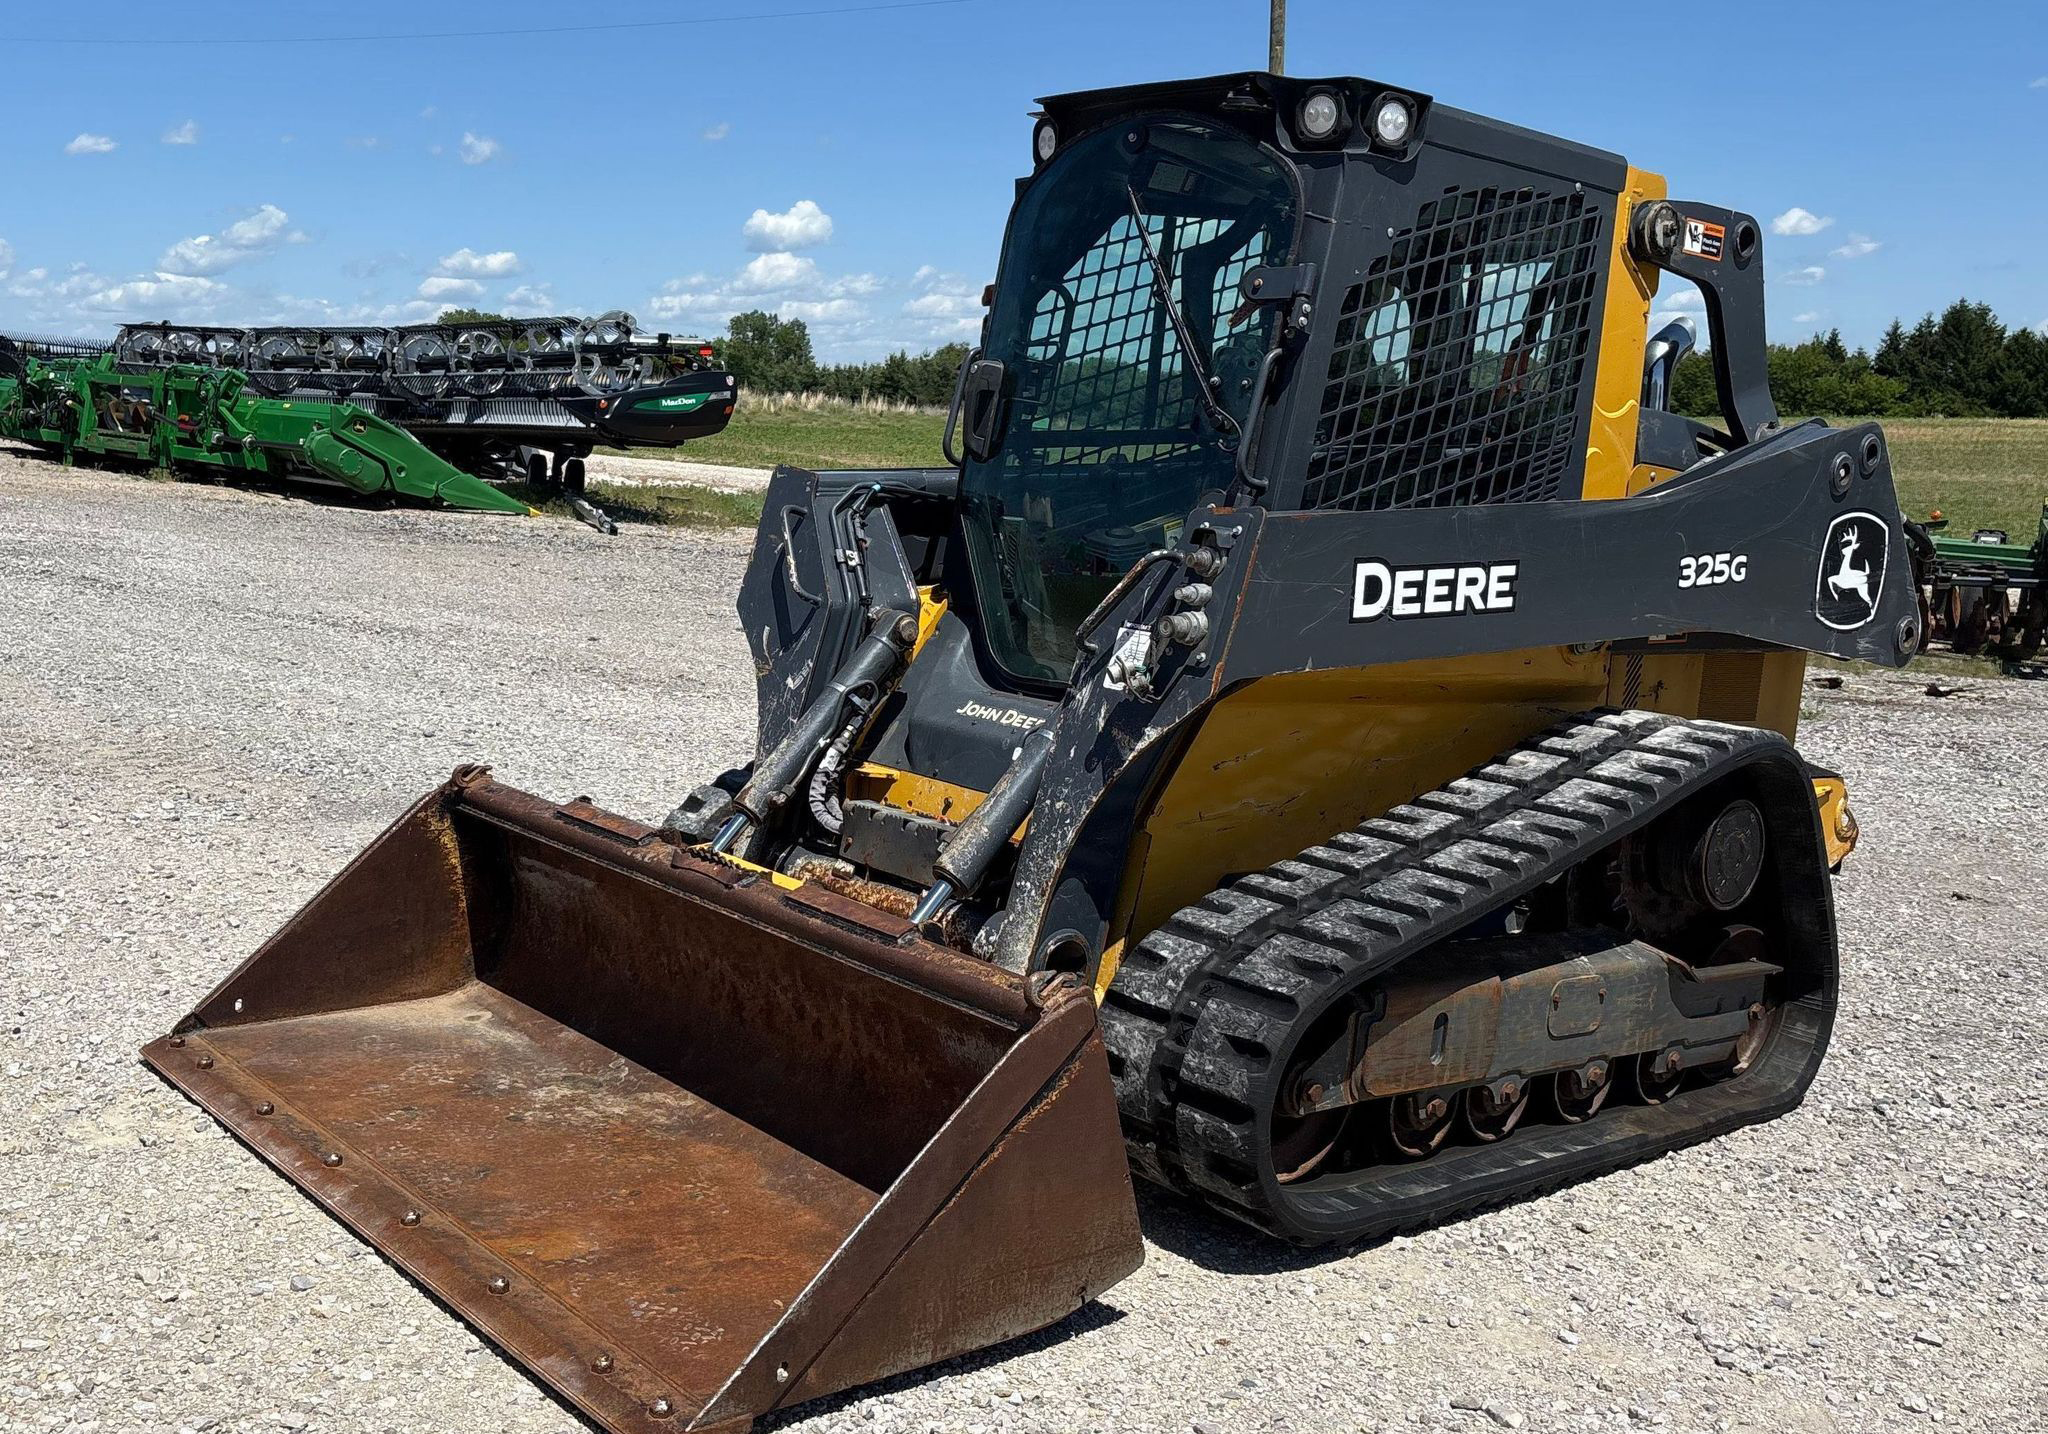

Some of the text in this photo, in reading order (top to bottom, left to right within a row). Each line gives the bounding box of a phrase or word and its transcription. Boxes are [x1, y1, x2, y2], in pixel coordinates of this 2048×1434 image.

[661, 397, 696, 406] MacDon
[1678, 553, 1748, 588] 325G
[1352, 562, 1517, 618] DEERE
[956, 700, 1047, 729] JOHN DEE
